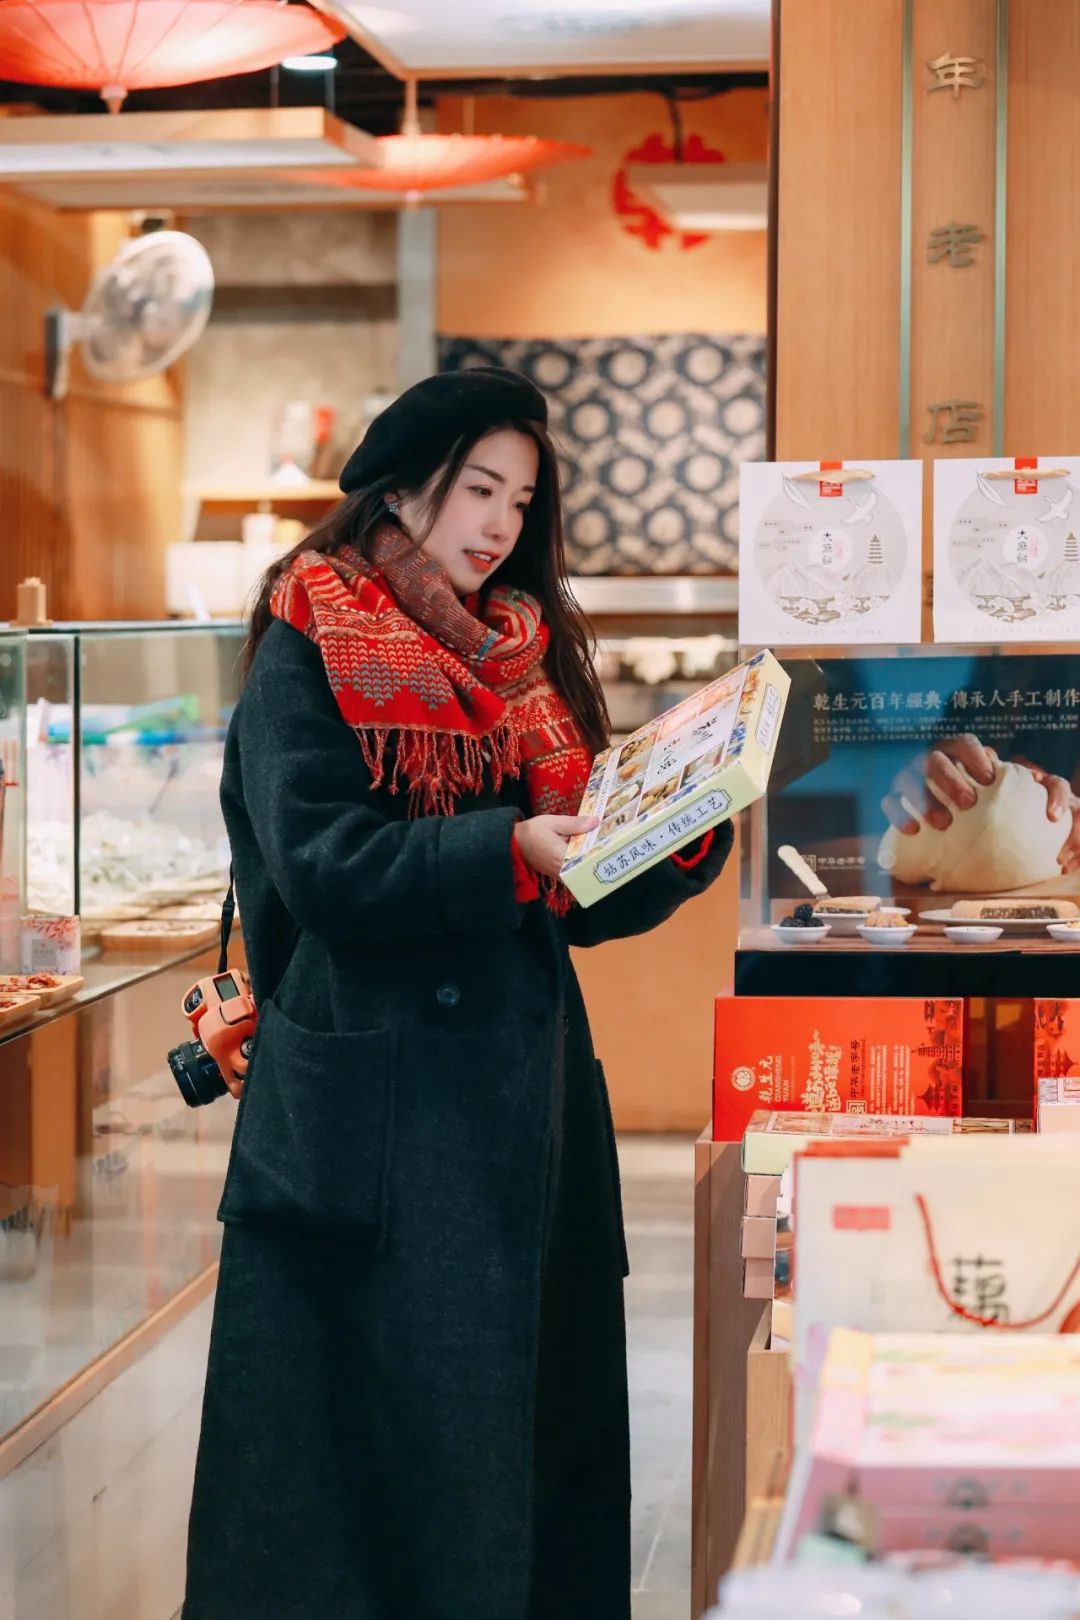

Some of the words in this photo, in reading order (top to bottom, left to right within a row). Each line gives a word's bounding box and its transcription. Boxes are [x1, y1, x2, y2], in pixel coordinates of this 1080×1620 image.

[925, 52, 985, 445] 年老店
[758, 1055, 773, 1104] 乾生元
[782, 1079, 790, 1102] YUAN
[850, 1039, 861, 1098] 中华老字号
